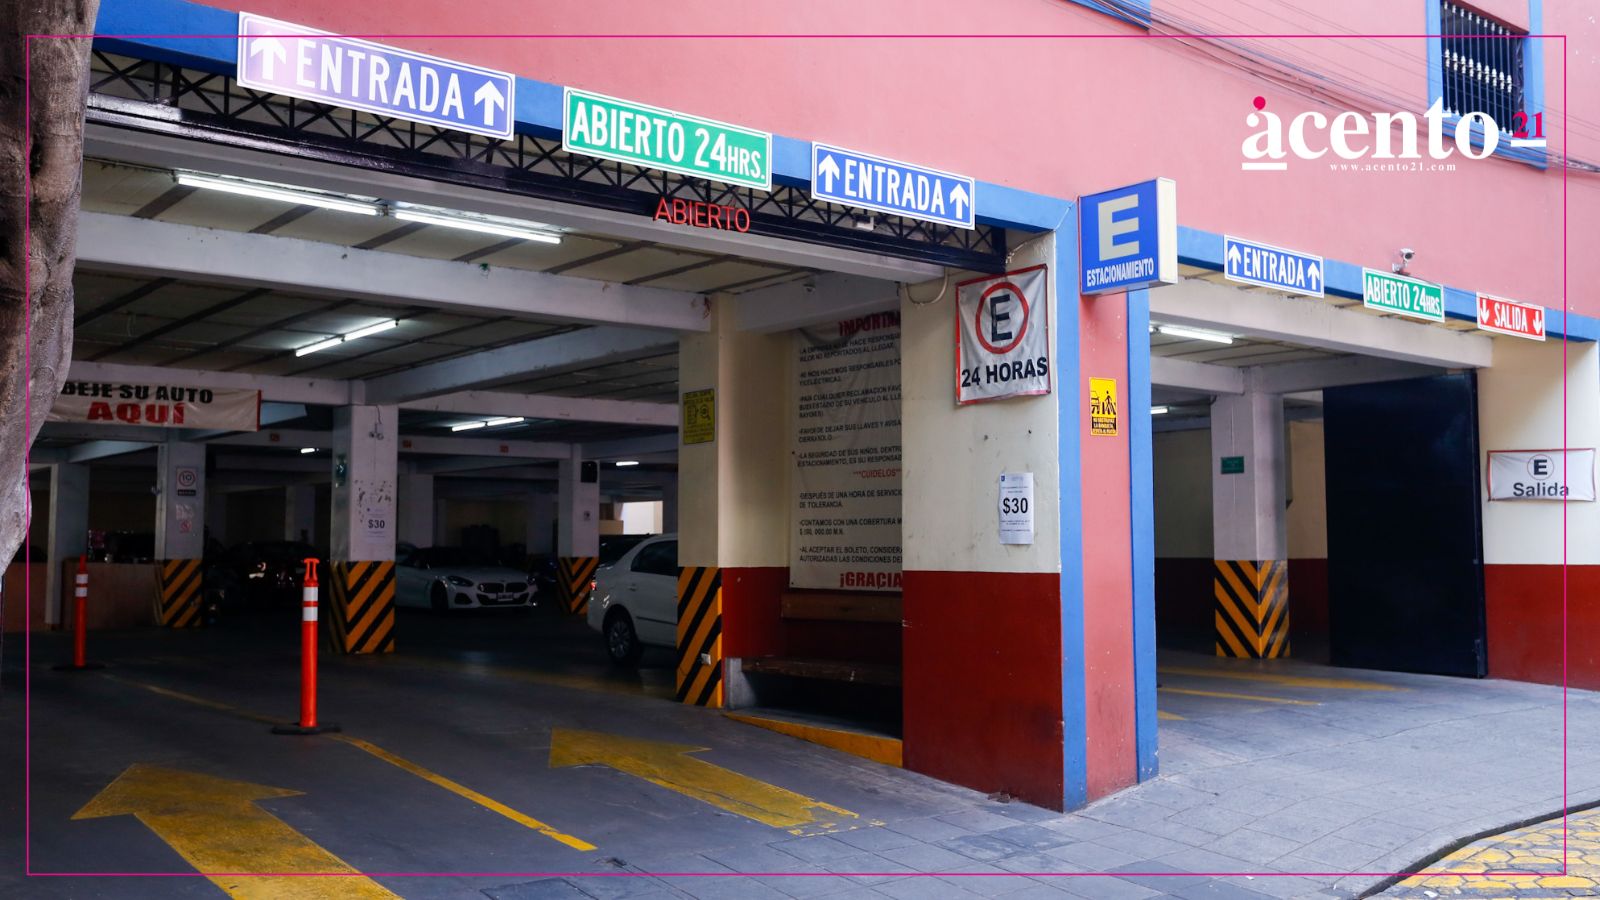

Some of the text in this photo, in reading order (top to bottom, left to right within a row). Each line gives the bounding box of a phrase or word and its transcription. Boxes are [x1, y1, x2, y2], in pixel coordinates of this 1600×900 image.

[296, 38, 465, 120] ENTRADA
[571, 101, 686, 163] ABIERTO
[845, 158, 945, 215] ENTRADA
[653, 196, 750, 232] ABIERTO
[1098, 193, 1139, 261] E
[1086, 257, 1154, 287] ESTACIONAMIENTO
[1244, 247, 1305, 288] ENTRADA
[1367, 275, 1410, 309] ABIERTO
[990, 294, 1012, 342] E
[1494, 302, 1528, 332] SALIDA
[961, 356, 1048, 387] 24 HORAS
[120, 384, 149, 399] SU
[155, 386, 213, 403] AUTO
[87, 402, 184, 424] AQUÍ
[1534, 459, 1547, 475] E
[1513, 482, 1569, 497] Salida
[1002, 496, 1028, 516] $30
[368, 519, 385, 529] $30
[852, 555, 891, 563] CONDICIONES
